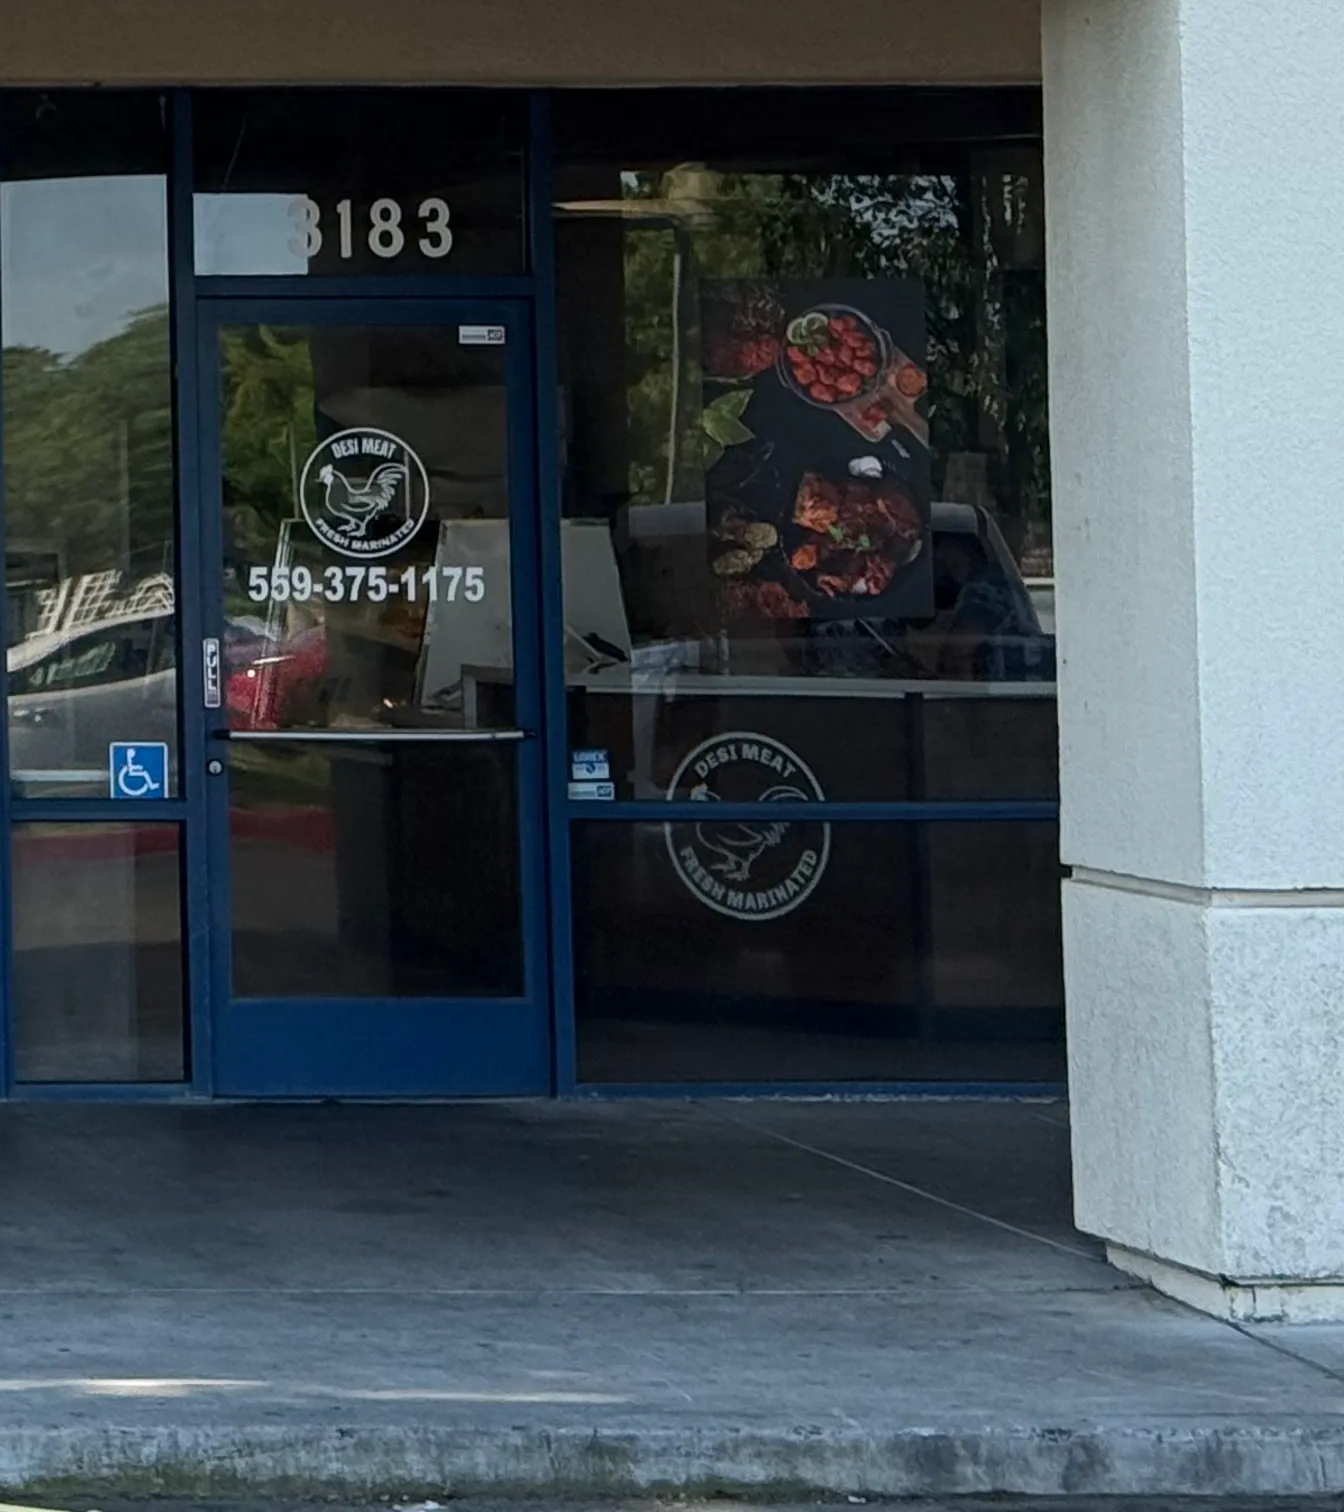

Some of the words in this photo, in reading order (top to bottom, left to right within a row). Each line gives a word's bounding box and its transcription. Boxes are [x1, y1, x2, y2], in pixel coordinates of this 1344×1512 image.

[287, 198, 453, 258] 3183
[331, 438, 358, 459] DESI
[362, 438, 397, 459] MEAT
[315, 518, 350, 548] FRESH
[351, 518, 415, 551] MARINATED
[248, 566, 485, 602] 559-375-1175
[206, 643, 217, 690] PULL
[694, 744, 738, 778] DESI
[742, 744, 796, 777] MEAT
[680, 846, 726, 901] FRESH
[727, 849, 817, 910] MARINATED
